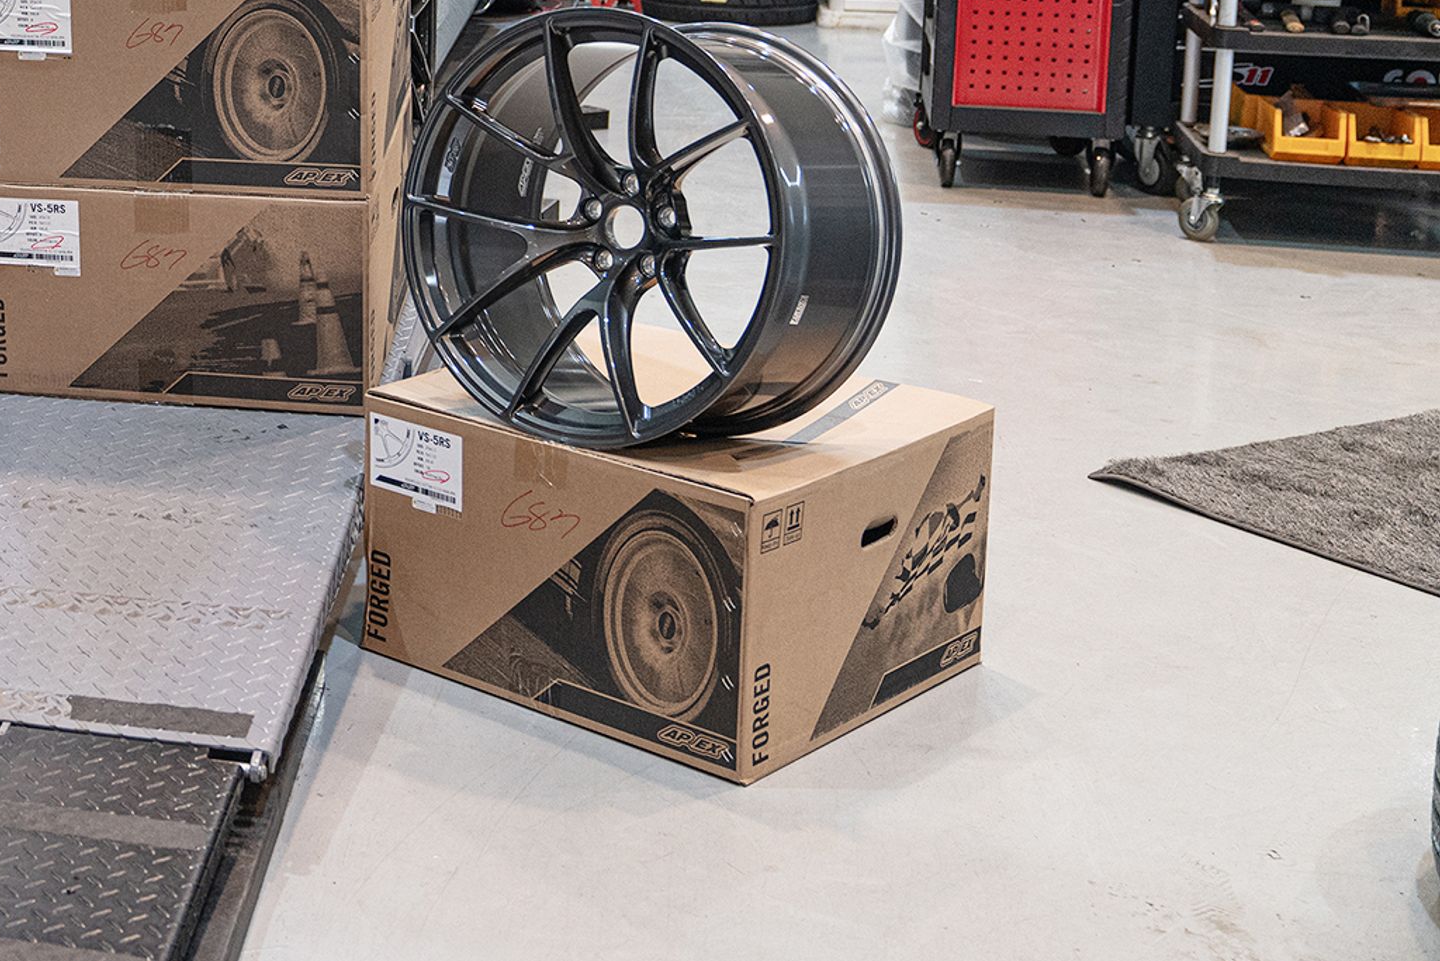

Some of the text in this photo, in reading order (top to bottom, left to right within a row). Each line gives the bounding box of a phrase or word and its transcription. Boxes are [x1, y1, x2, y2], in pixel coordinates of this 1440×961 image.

[286, 168, 348, 185] APEX
[30, 203, 66, 214] VS-5RS
[289, 384, 355, 401] APEX
[418, 431, 451, 449] VS-5RS
[367, 550, 391, 642] FORGED
[752, 663, 771, 767] FORGED
[658, 726, 729, 759] APEX
